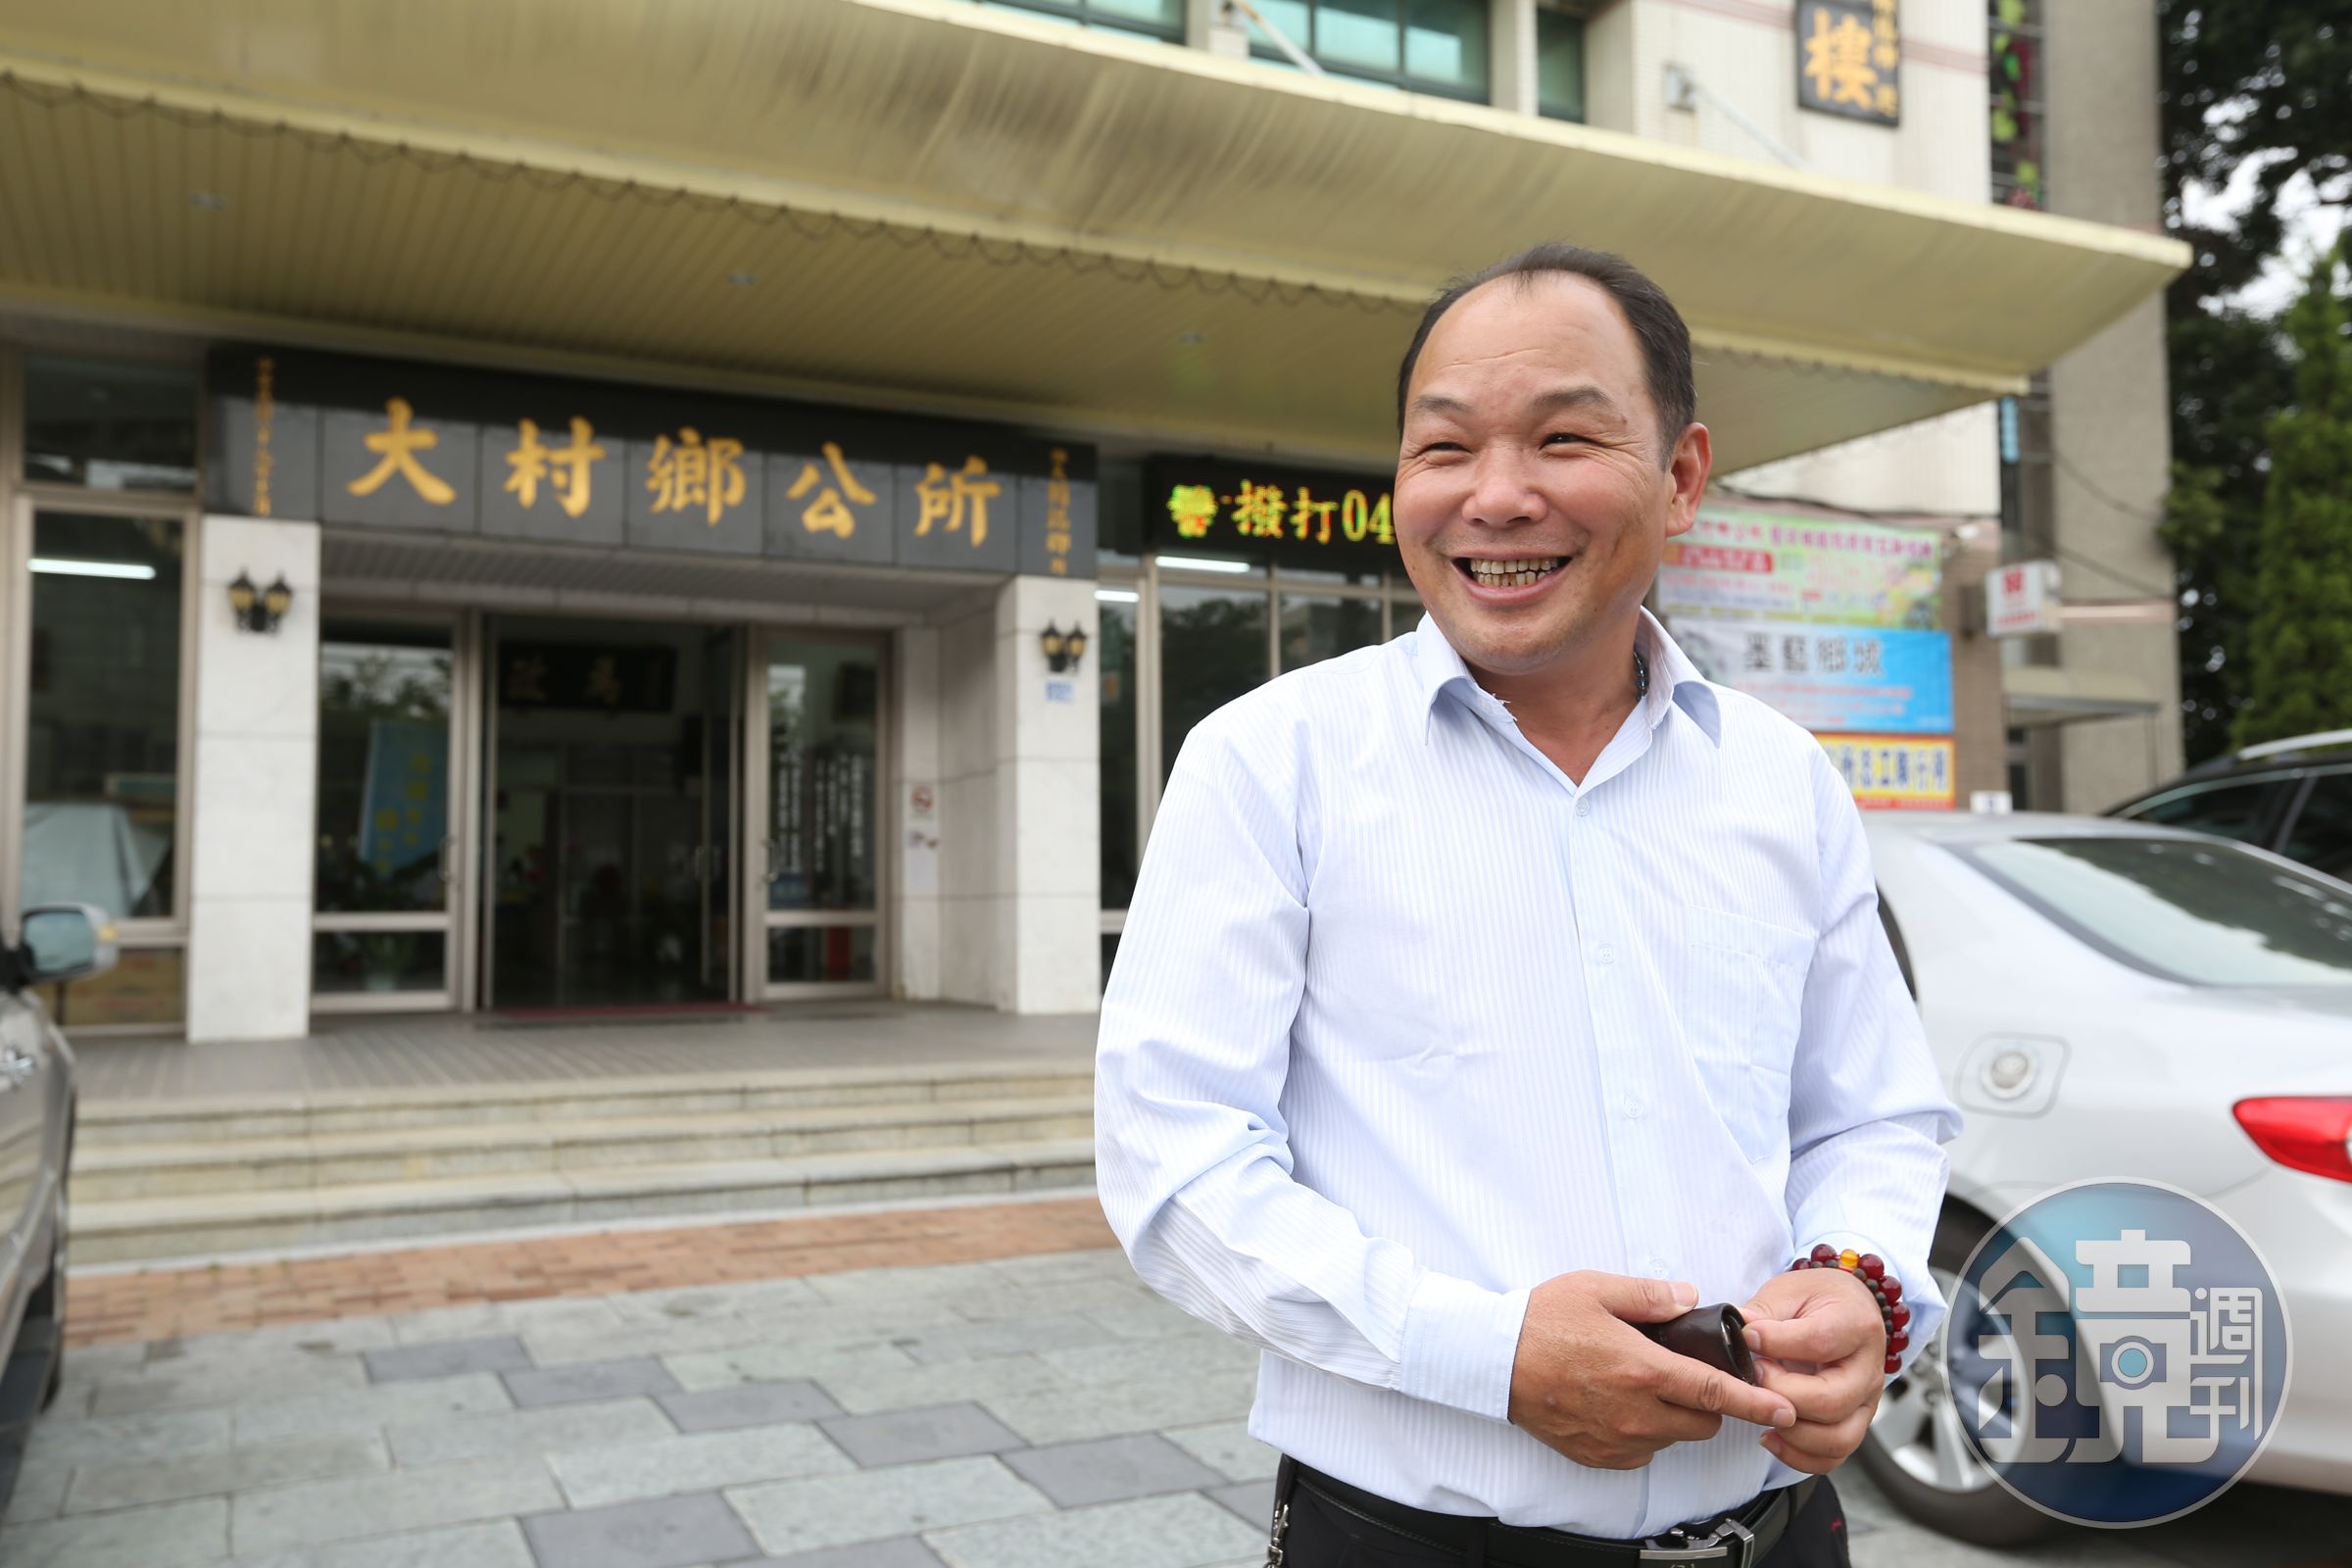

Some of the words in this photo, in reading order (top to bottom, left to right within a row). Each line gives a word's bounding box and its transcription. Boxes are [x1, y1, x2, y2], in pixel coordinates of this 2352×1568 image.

[347, 397, 1002, 549] 大村鄉公所
